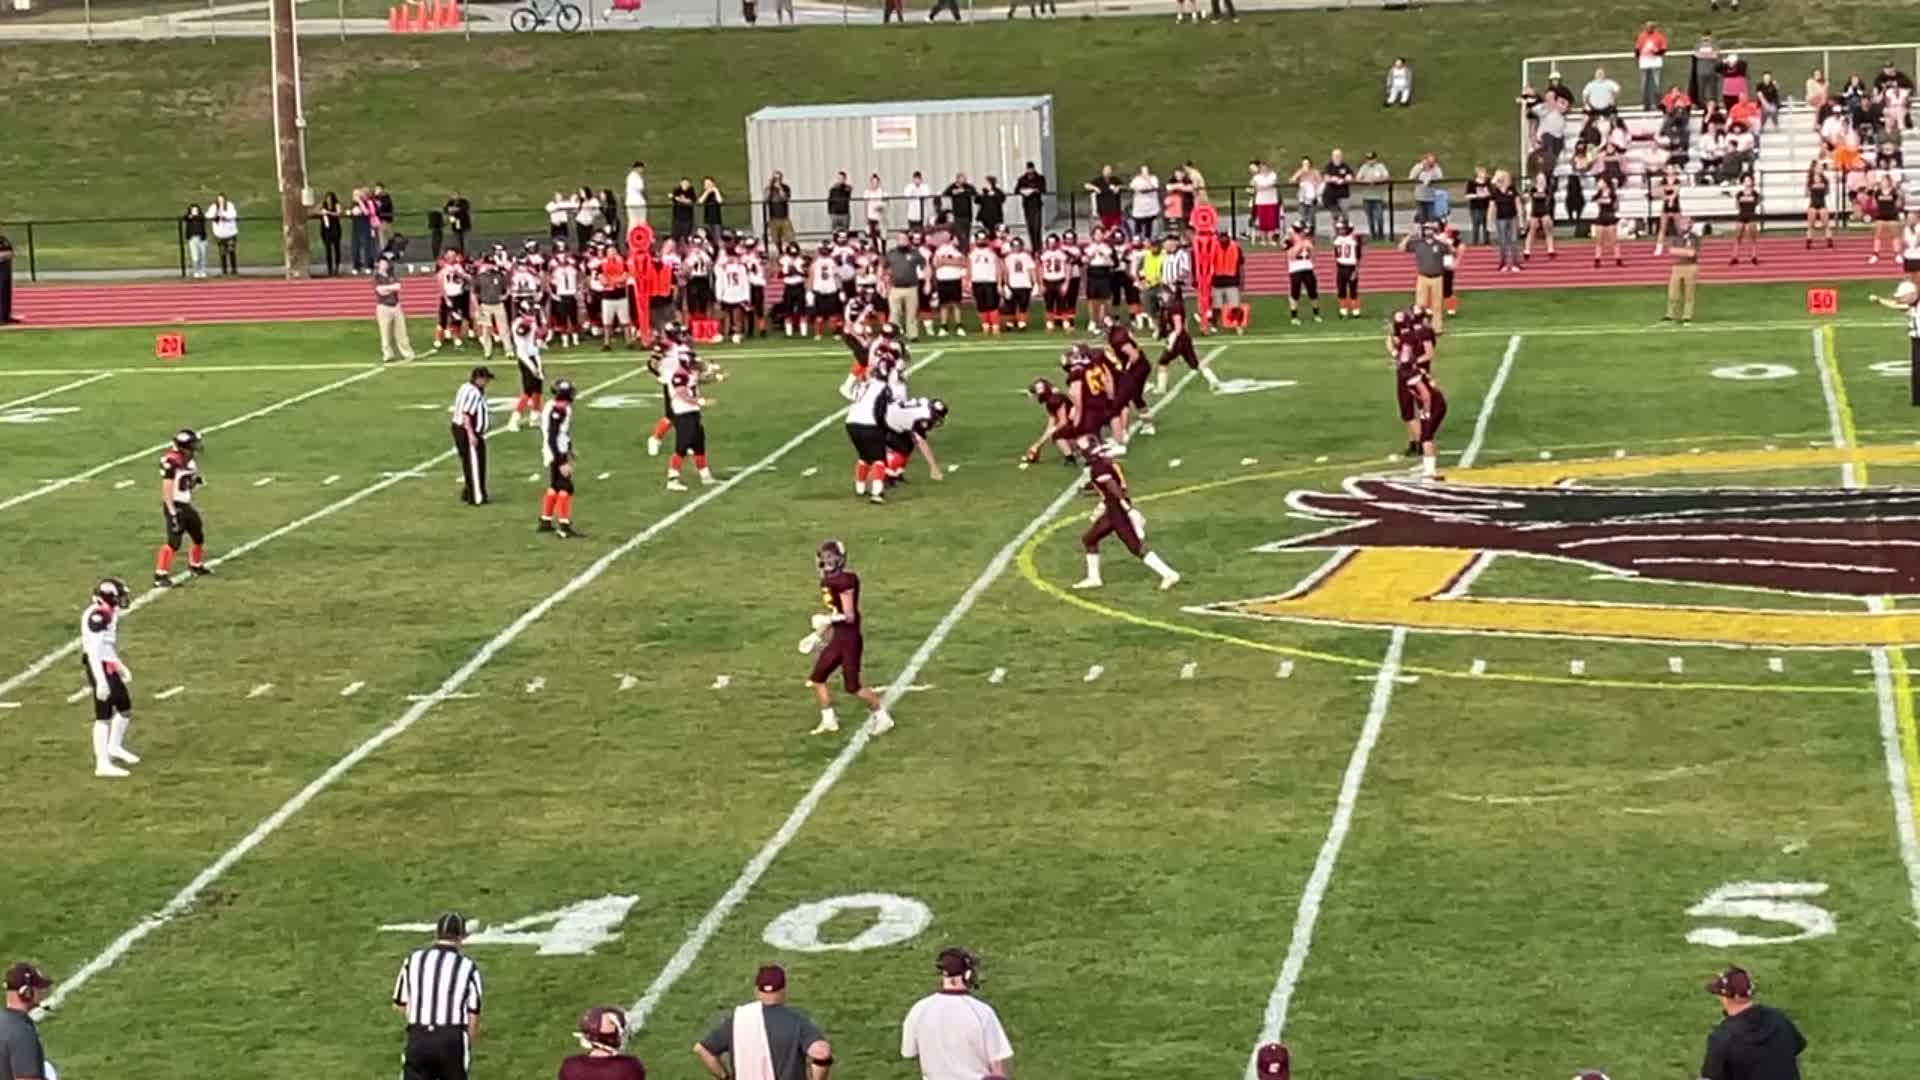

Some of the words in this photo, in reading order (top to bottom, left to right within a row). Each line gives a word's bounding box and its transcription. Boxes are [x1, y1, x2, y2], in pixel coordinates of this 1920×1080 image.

[1813, 292, 1833, 309] 50
[161, 337, 178, 353] 20
[763, 893, 933, 951] 0
[1685, 881, 1837, 947] 5
